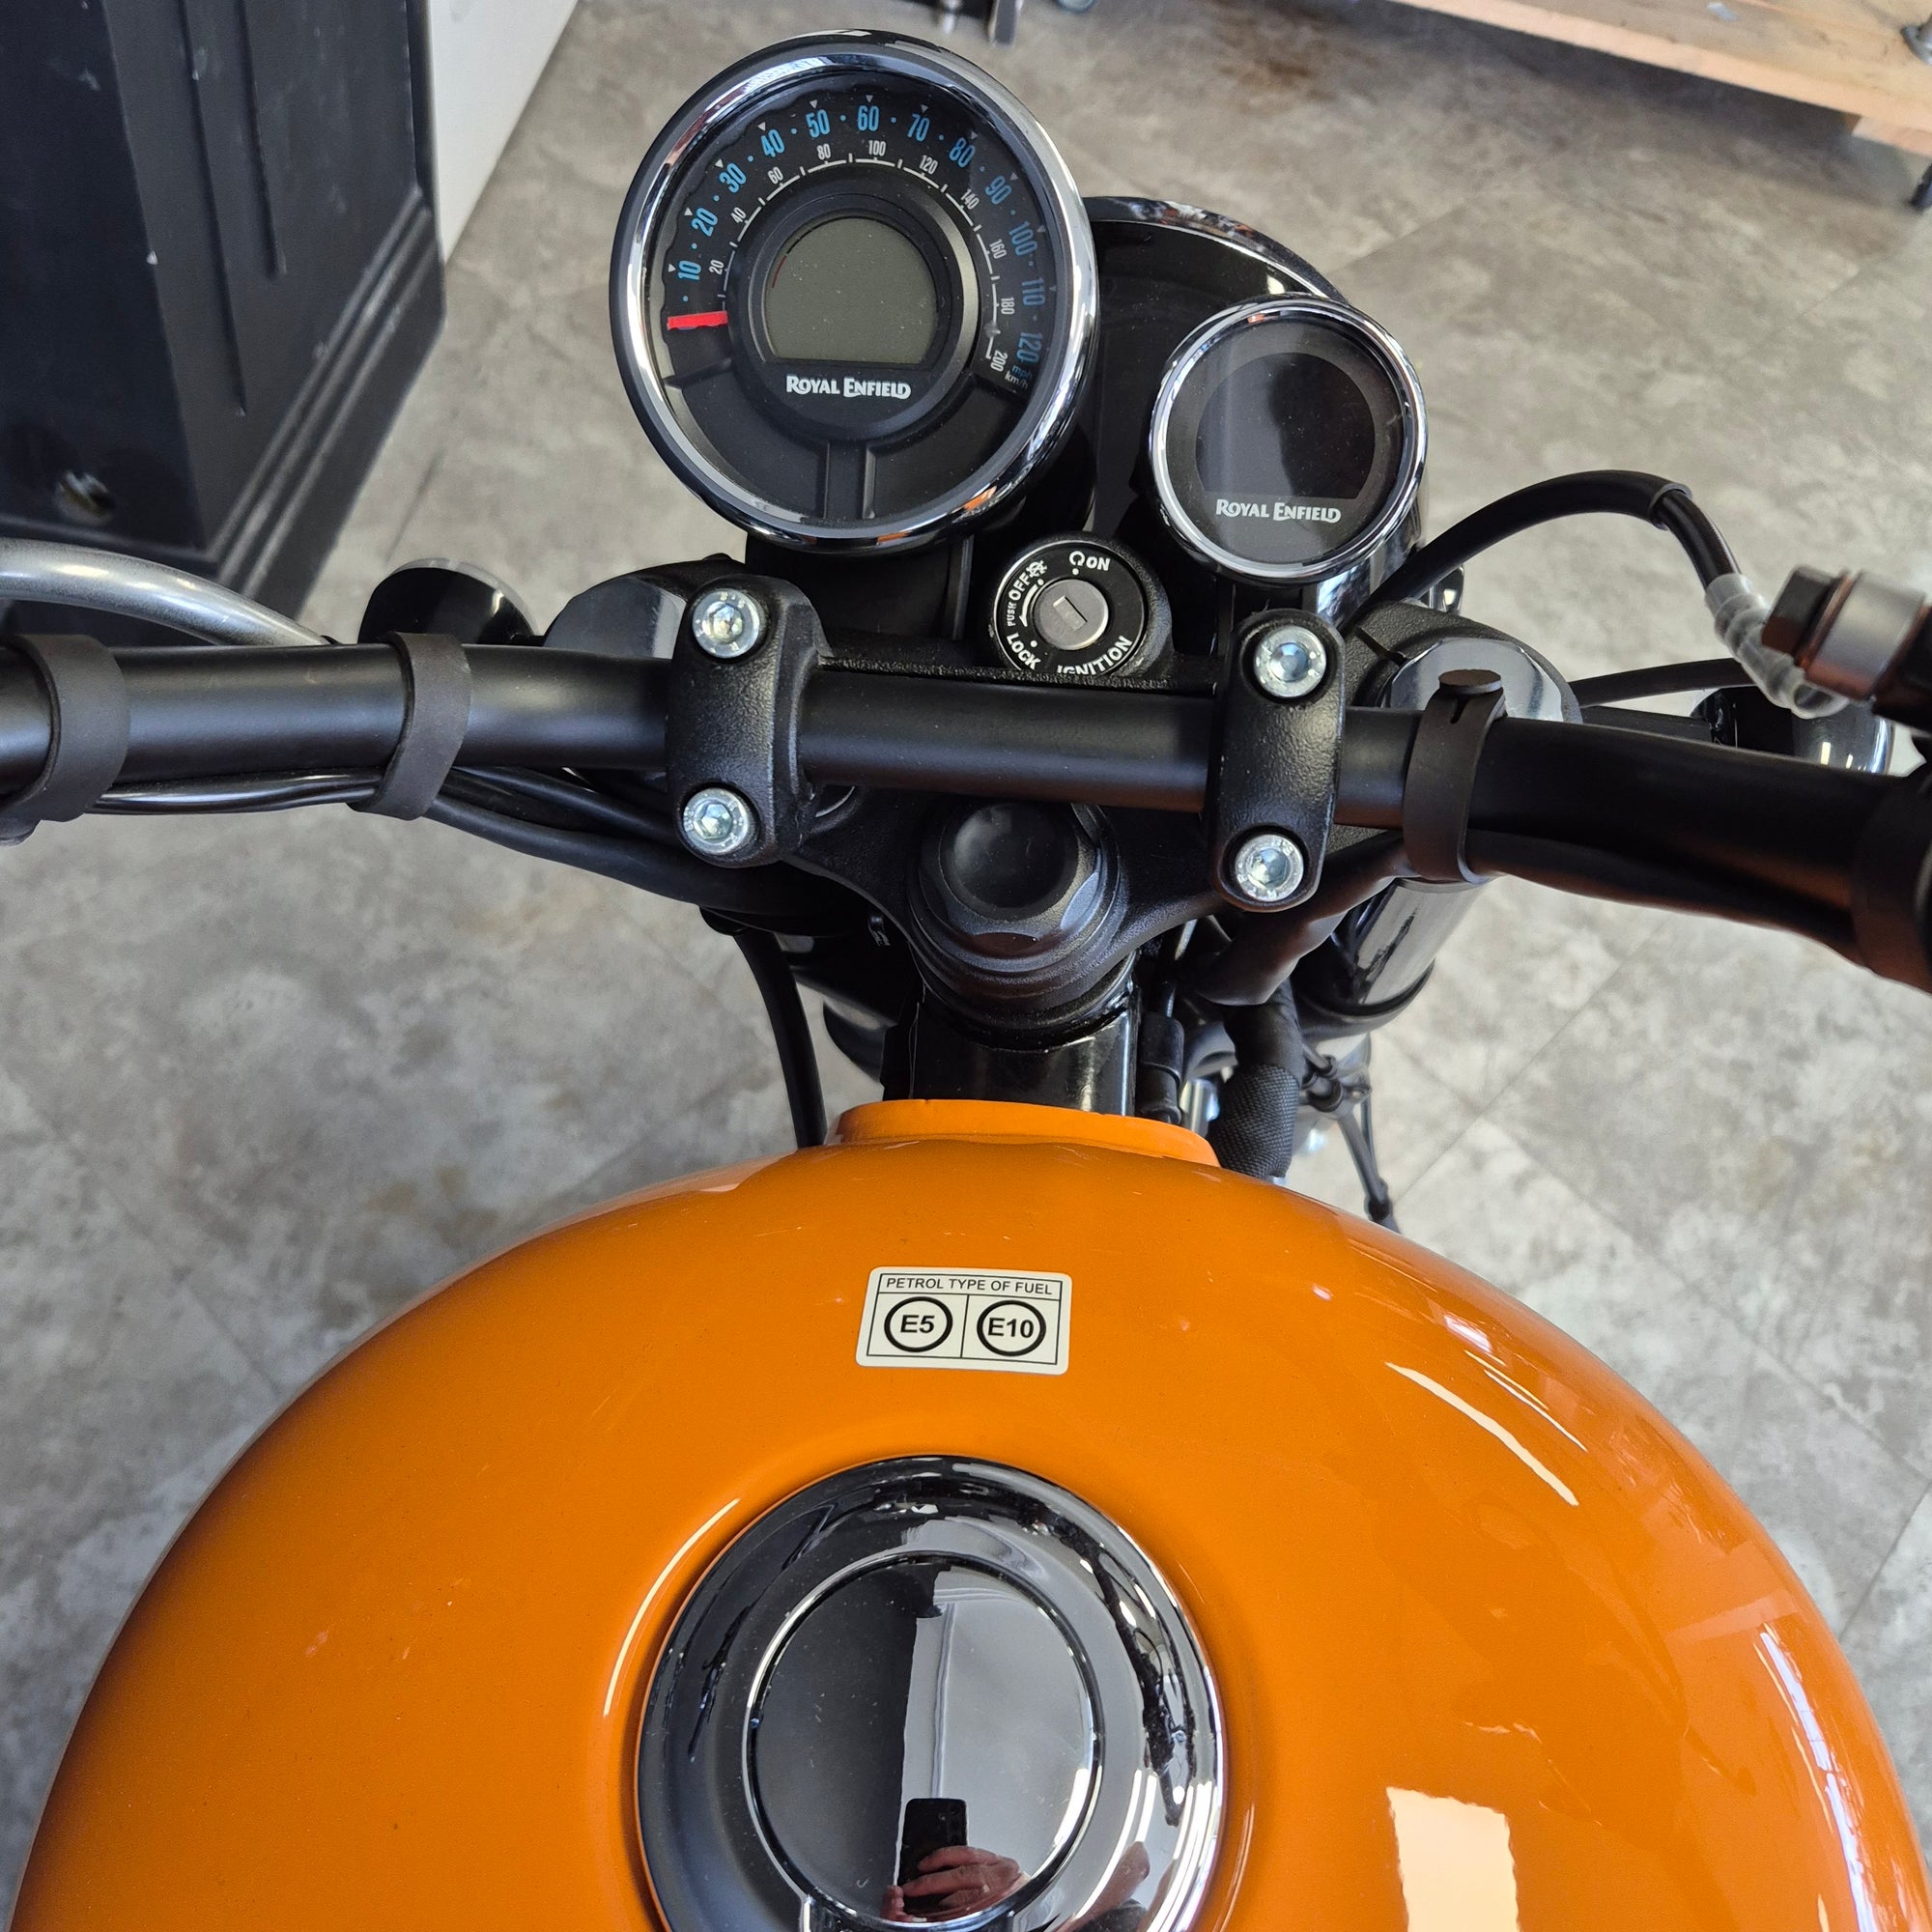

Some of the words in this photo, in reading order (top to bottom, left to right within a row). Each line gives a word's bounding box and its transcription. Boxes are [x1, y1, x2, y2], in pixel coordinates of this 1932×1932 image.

[805, 108, 832, 138] 50
[857, 104, 880, 132] 60
[906, 113, 931, 142] 70
[760, 128, 785, 157] 40
[816, 143, 832, 160] 80
[867, 139, 887, 156] 100
[949, 137, 976, 168] 80
[767, 166, 783, 185] 60
[919, 155, 939, 175] 120
[719, 162, 748, 193] 30
[959, 188, 980, 211] 140
[984, 175, 1012, 206] 90
[691, 207, 719, 238] 20
[730, 207, 747, 224] 40
[988, 239, 1008, 260] 160
[1008, 220, 1038, 257] 100
[677, 260, 702, 281] 10
[709, 259, 724, 275] 20
[1020, 276, 1046, 307] 110
[1000, 296, 1015, 315] 180
[1016, 331, 1043, 364] 120
[990, 349, 1009, 372] 200
[1004, 370, 1029, 389] km/h
[1011, 364, 1033, 381] mph
[1086, 556, 1111, 571] ON
[1009, 572, 1031, 601] OFF
[1007, 602, 1017, 627] PUSH
[1006, 633, 1041, 670] LOCK
[886, 1277, 944, 1290] PETROL
[949, 1278, 986, 1291] TYPE
[990, 1280, 1010, 1292] OF
[1014, 1282, 1053, 1295] FUEL
[899, 1314, 935, 1334] E5
[987, 1317, 1035, 1339] E10
